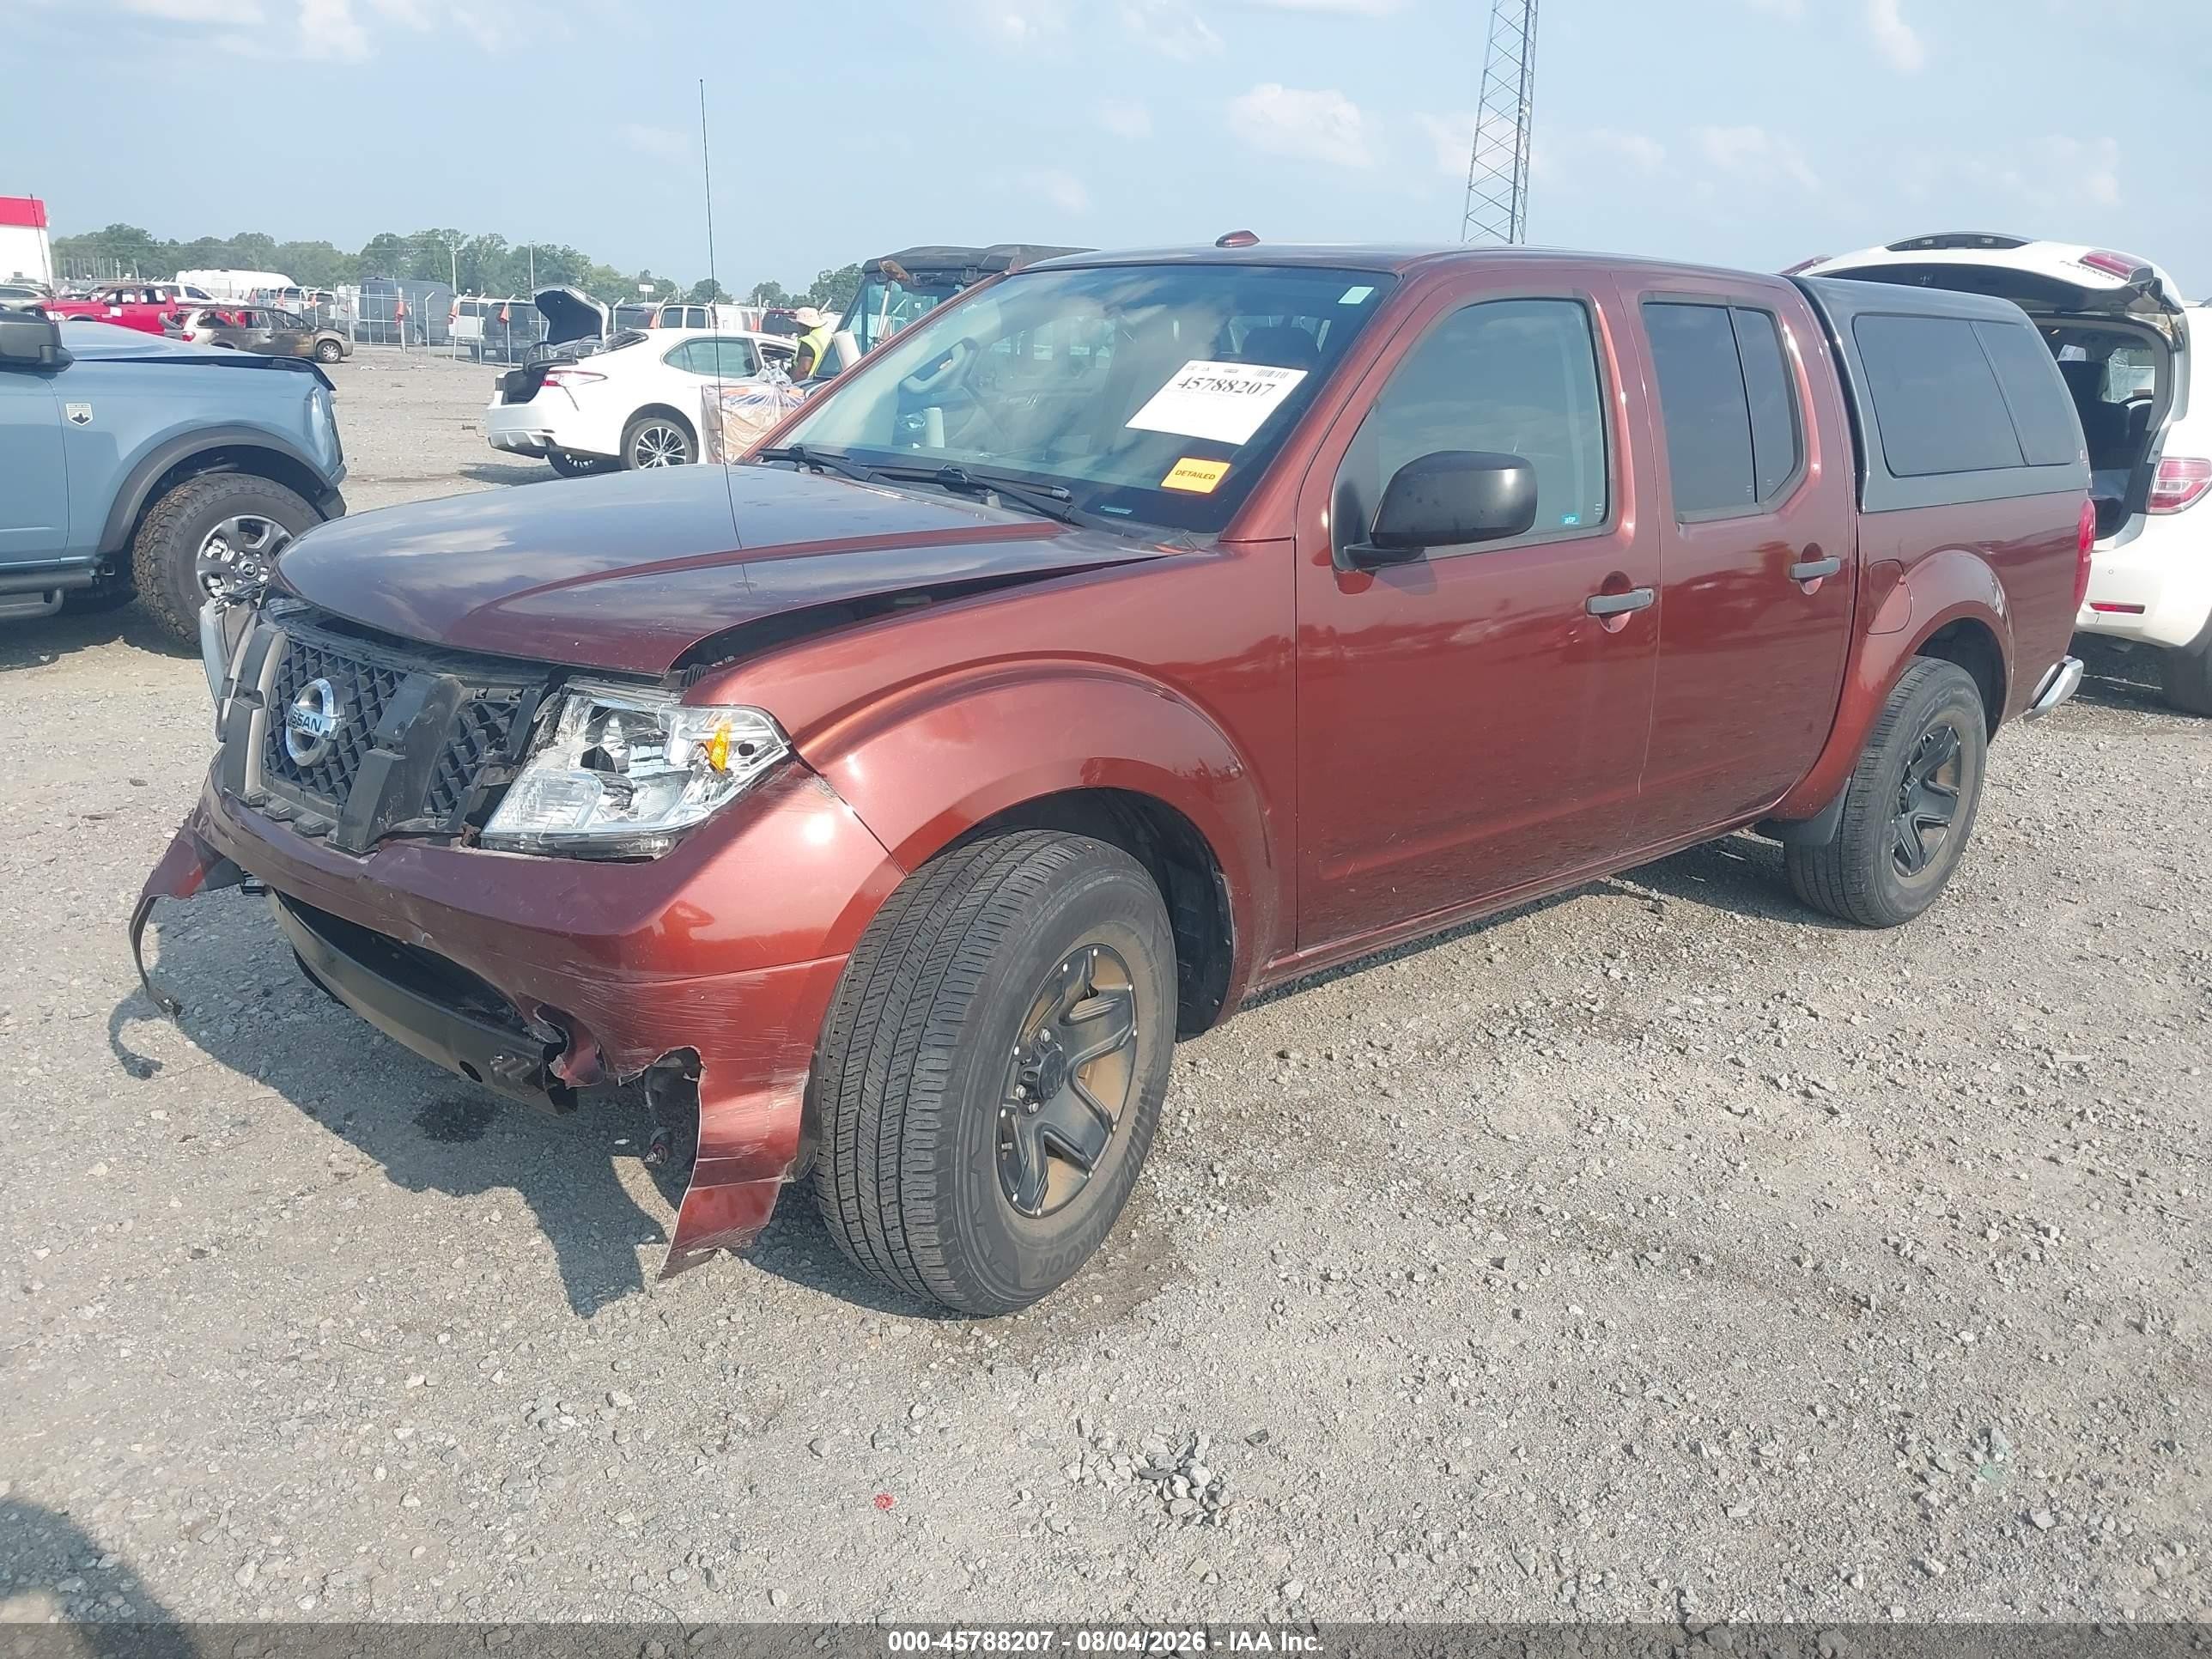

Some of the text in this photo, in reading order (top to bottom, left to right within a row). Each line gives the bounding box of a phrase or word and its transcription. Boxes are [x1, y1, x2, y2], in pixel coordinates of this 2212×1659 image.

[1177, 376, 1277, 397] 45788207
[1175, 468, 1216, 481] DETAILED
[288, 711, 322, 732] SSAN
